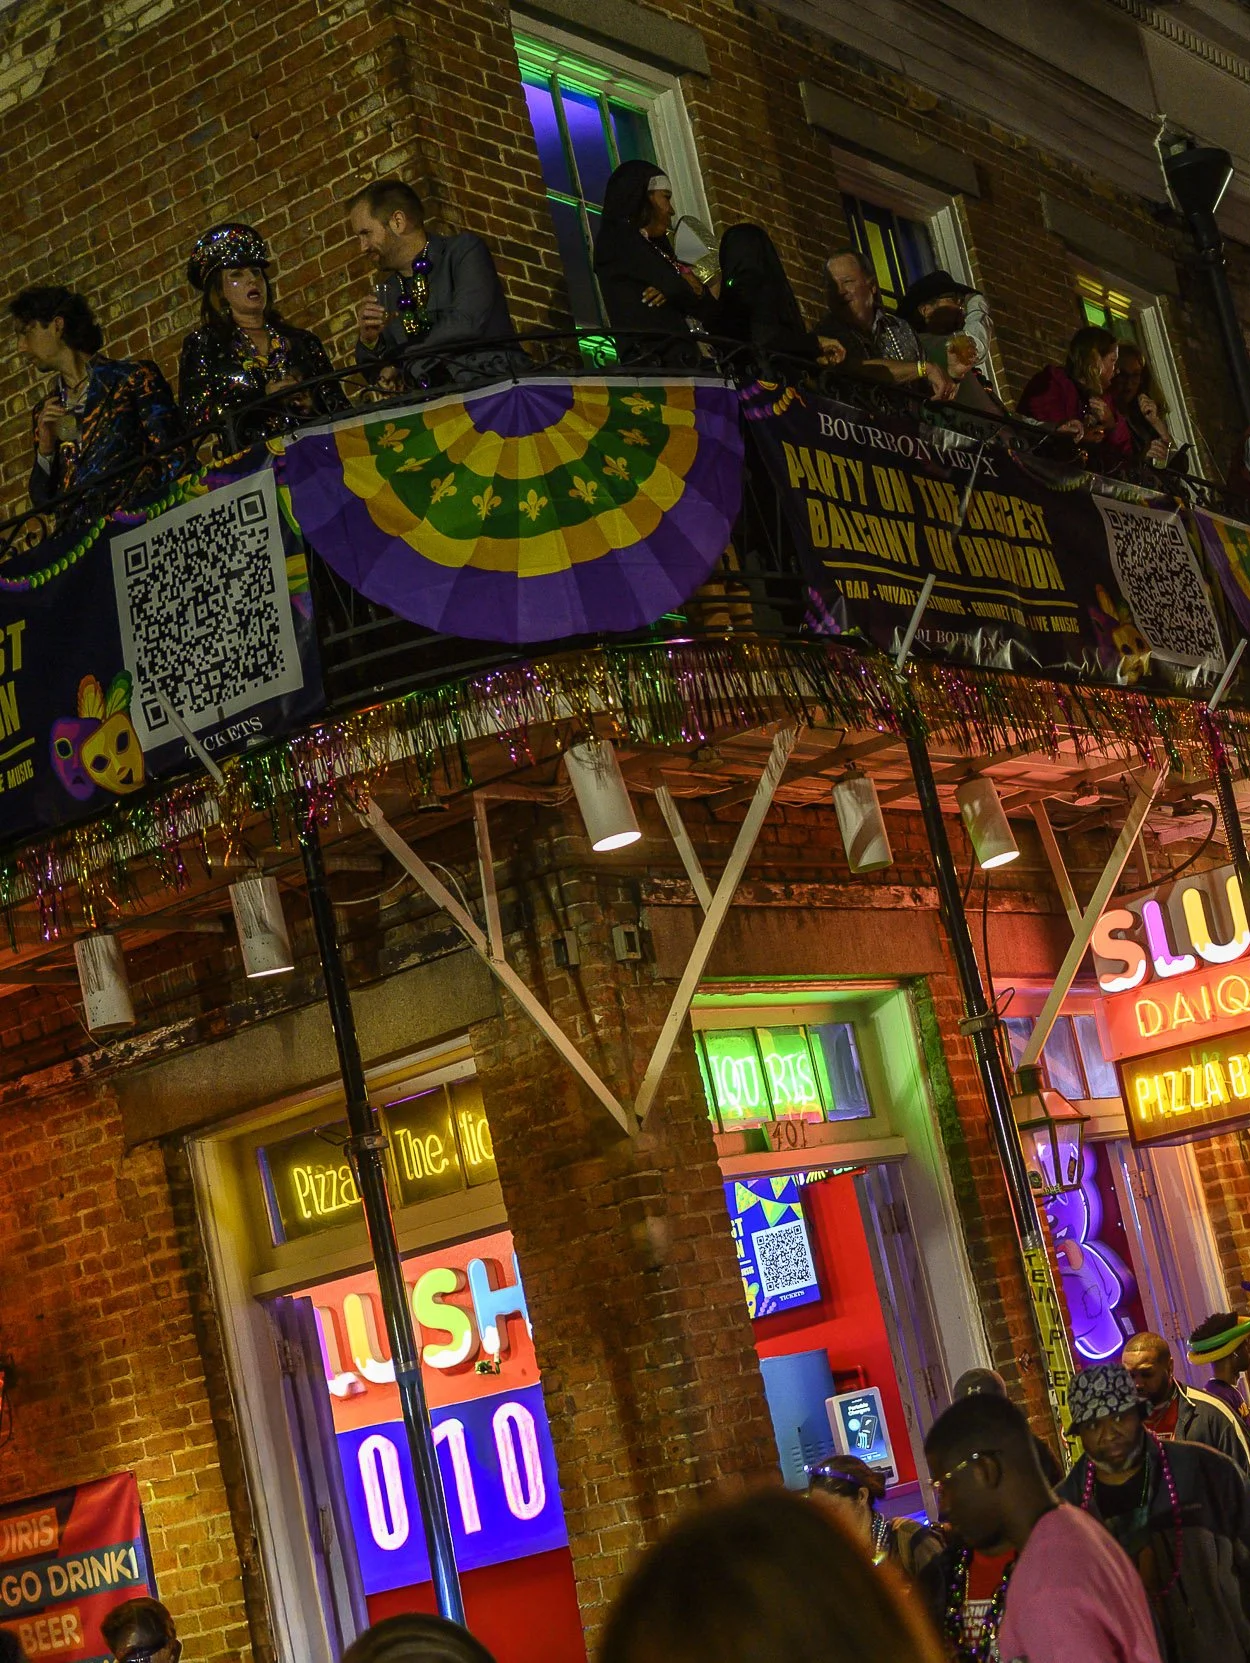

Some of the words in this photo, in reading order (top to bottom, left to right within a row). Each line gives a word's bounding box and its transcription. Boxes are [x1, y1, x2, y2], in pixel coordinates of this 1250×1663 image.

[817, 412, 932, 461] BOURBON
[782, 441, 868, 506] PARTY
[872, 464, 915, 514] ON
[912, 474, 966, 527] THE
[966, 489, 1052, 545] BIGGEST
[806, 497, 921, 568] BALCONY
[924, 524, 962, 576] ON
[959, 535, 1066, 592] BOURBON
[845, 580, 870, 600] BAR
[877, 583, 917, 605] PRIVATE
[917, 590, 966, 616] STROOMS
[1028, 612, 1050, 632] LIVE
[1050, 616, 1080, 634] MUSIC
[936, 630, 996, 651] BOURON
[184, 717, 263, 759] TCKETS
[7, 759, 34, 789] MUSIC
[711, 1052, 817, 1116] IQURIS
[1136, 1058, 1227, 1119] PIZZA
[772, 1120, 809, 1150] 401
[293, 1165, 363, 1219] Pizza
[395, 1127, 449, 1181] The
[779, 1290, 805, 1301] TICKETS
[18, 1613, 81, 1652] BEER
